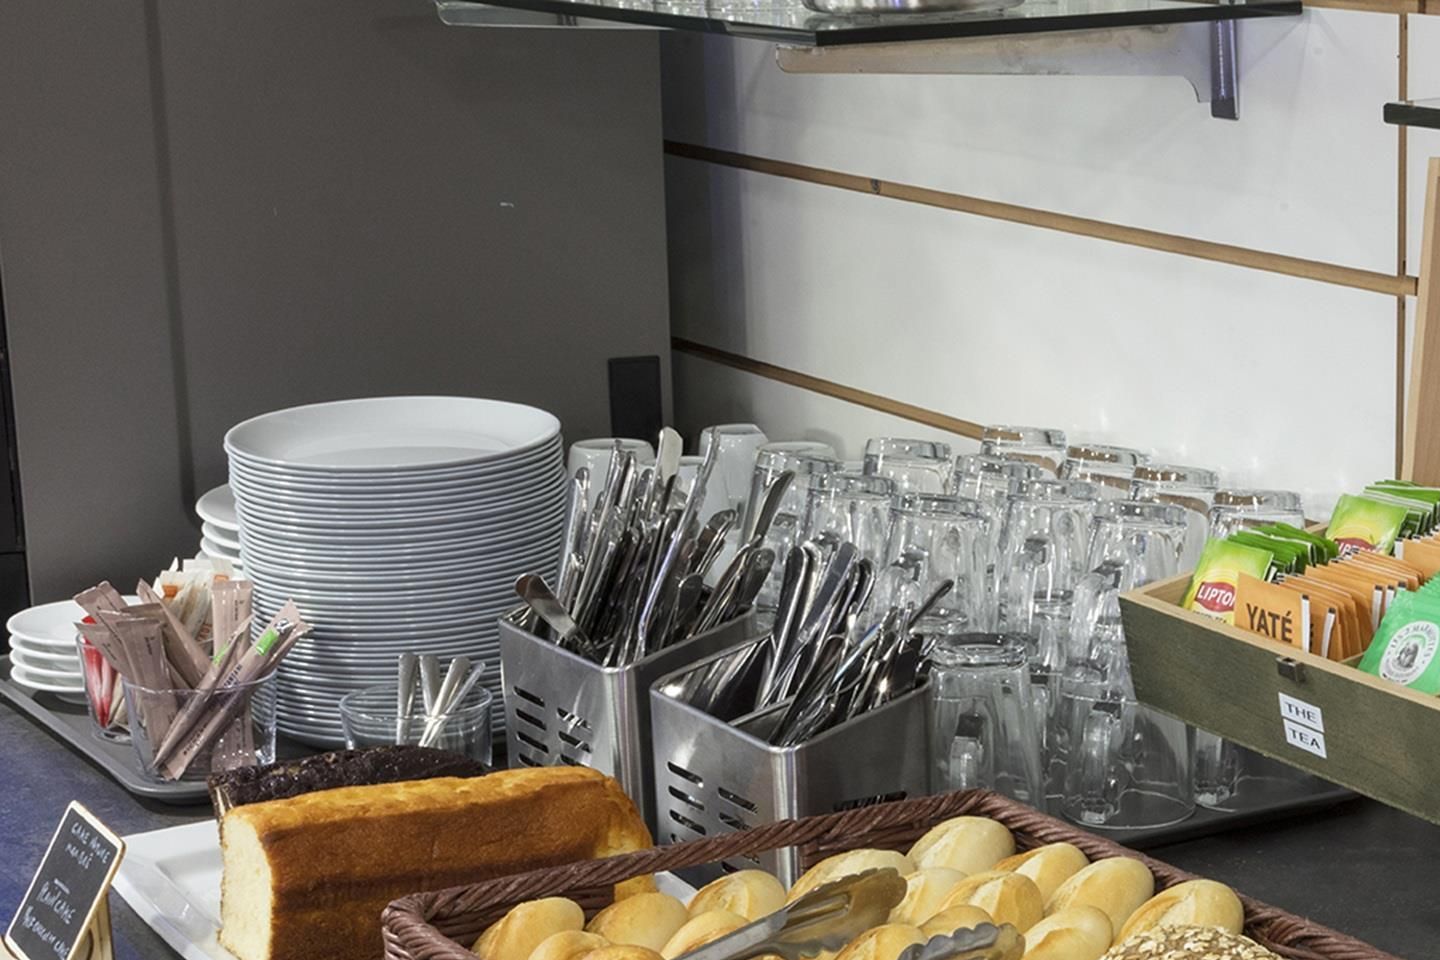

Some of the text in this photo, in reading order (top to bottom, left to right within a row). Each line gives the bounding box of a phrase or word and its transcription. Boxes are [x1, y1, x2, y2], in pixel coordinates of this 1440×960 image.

[1245, 602, 1294, 644] YATÉ
[1284, 702, 1318, 723] THE
[1289, 728, 1321, 751] TEA
